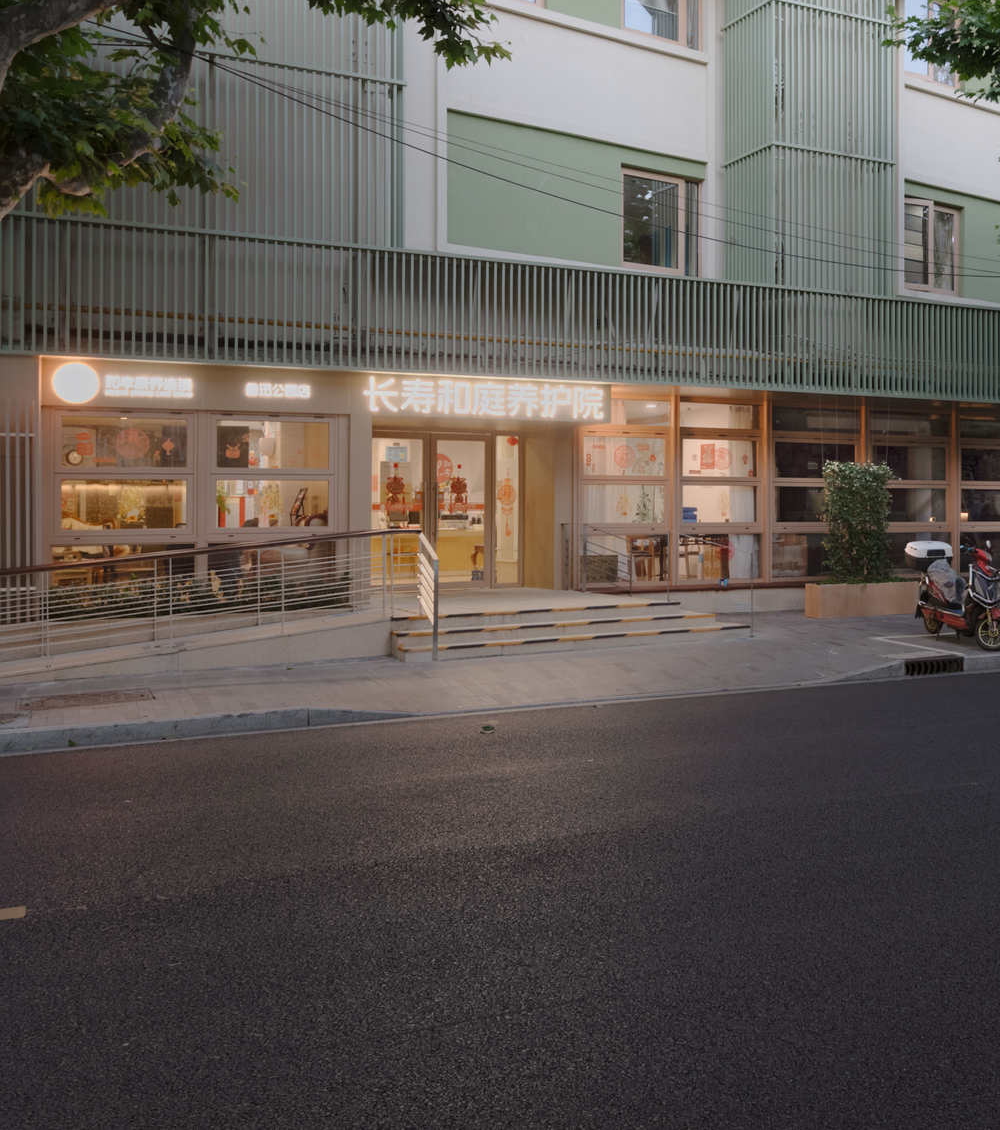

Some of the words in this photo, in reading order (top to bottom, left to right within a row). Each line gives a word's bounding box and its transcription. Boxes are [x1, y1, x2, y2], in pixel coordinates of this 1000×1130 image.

[363, 375, 604, 420] 长寿和庭养护院
